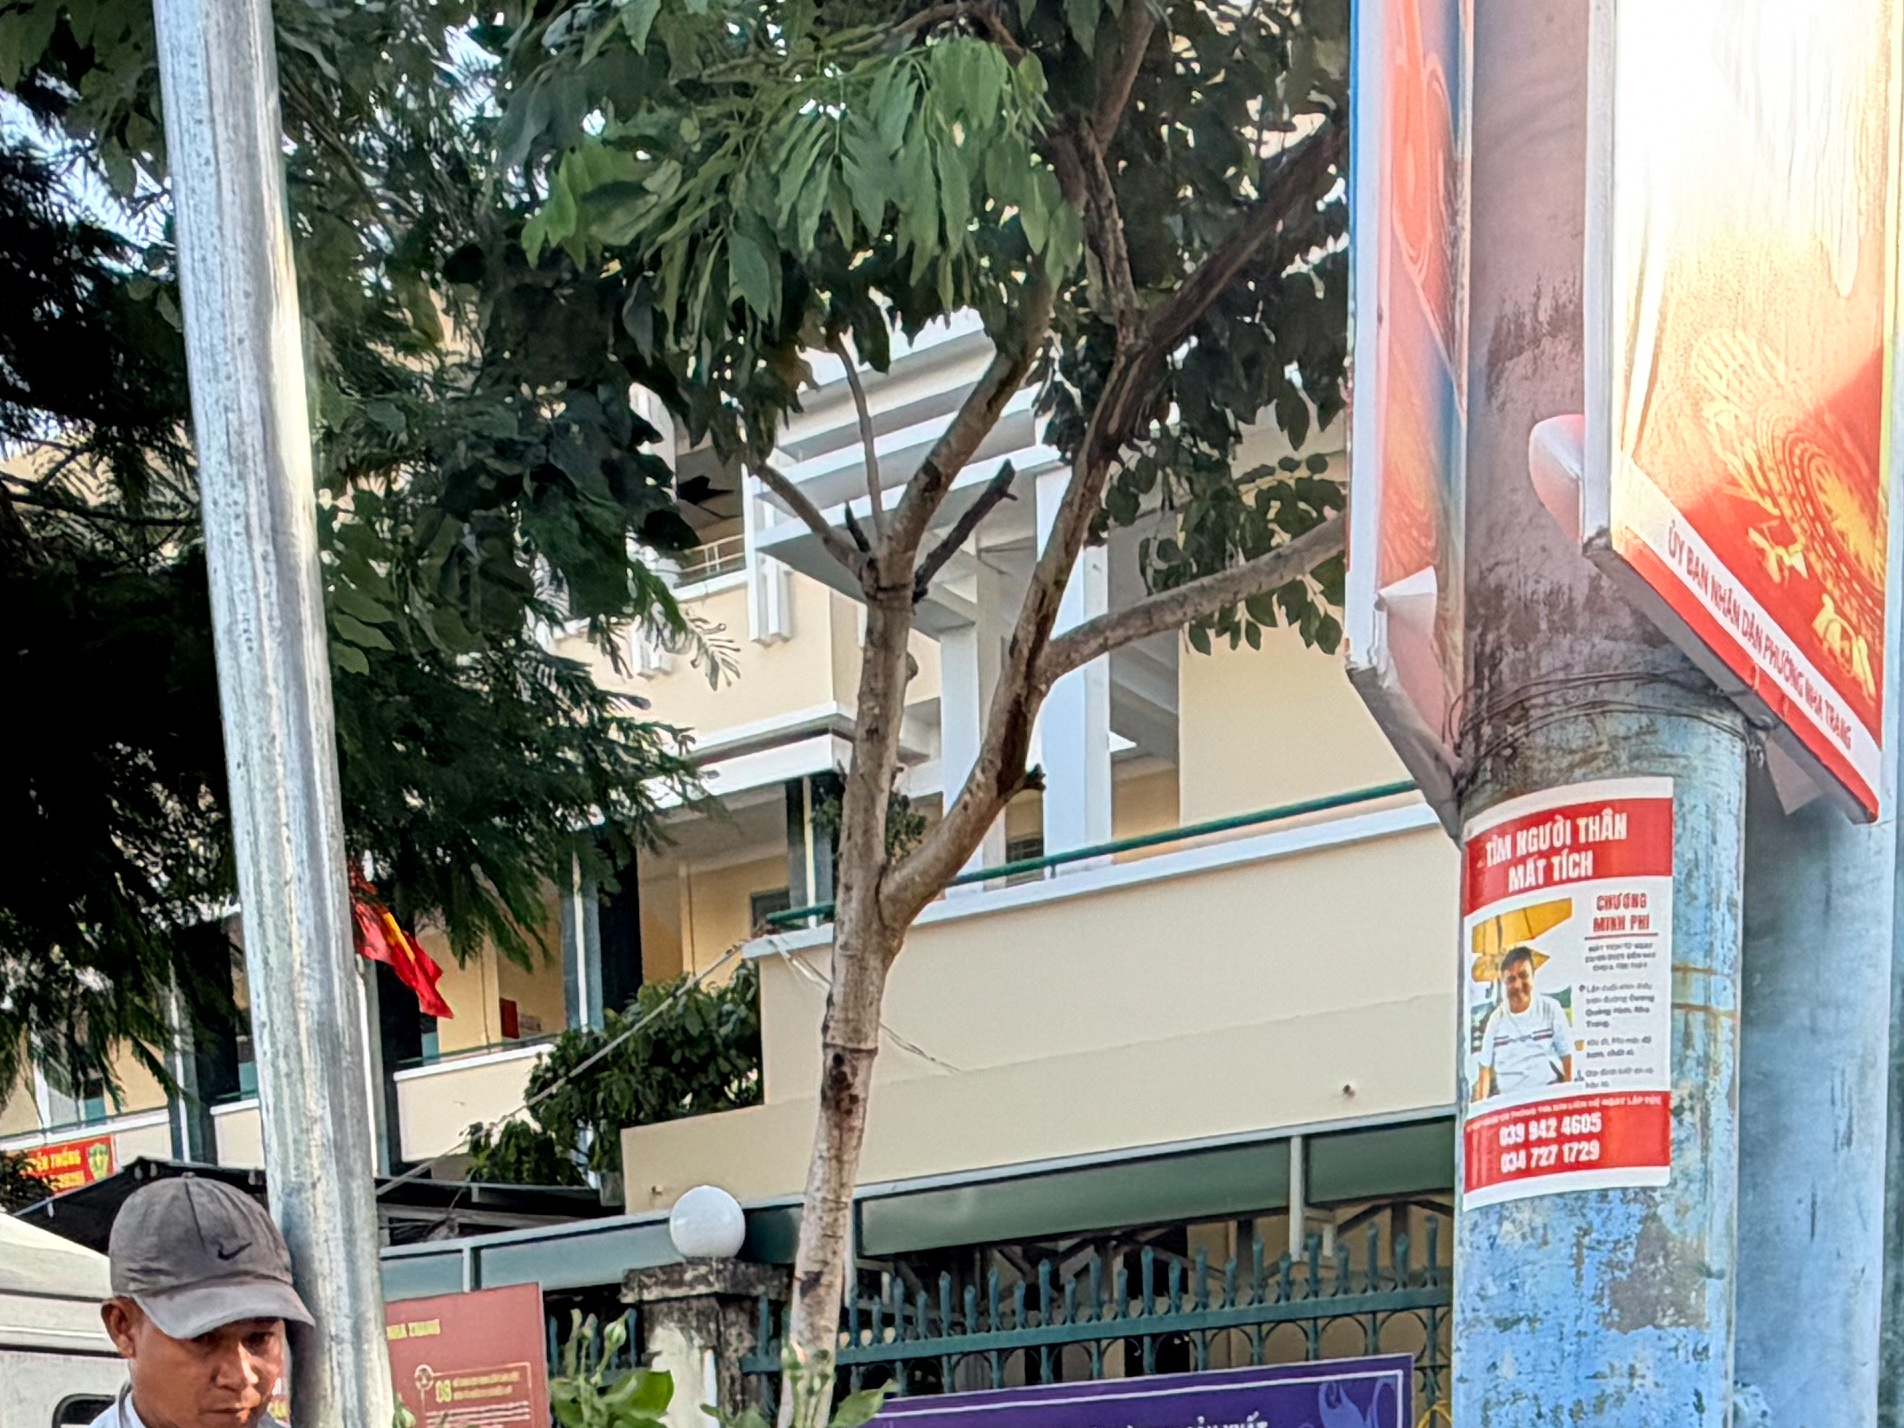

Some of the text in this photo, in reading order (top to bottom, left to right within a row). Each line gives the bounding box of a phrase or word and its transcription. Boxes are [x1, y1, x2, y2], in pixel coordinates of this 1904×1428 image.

[1668, 519, 1685, 566] ỦY
[1687, 546, 1709, 596] BAN
[1710, 575, 1740, 631] NHÂN
[1741, 609, 1764, 653] DÂN
[1763, 634, 1804, 697] PHƯỜNG
[1824, 699, 1851, 750] TRANG
[1485, 807, 1627, 868] TÌM NGƯỜI THÂN
[1508, 848, 1593, 893] MẤT TÍCH
[1561, 1112, 1602, 1136] 4605
[1531, 1144, 1558, 1168] 727
[1562, 1139, 1600, 1163] 1729
